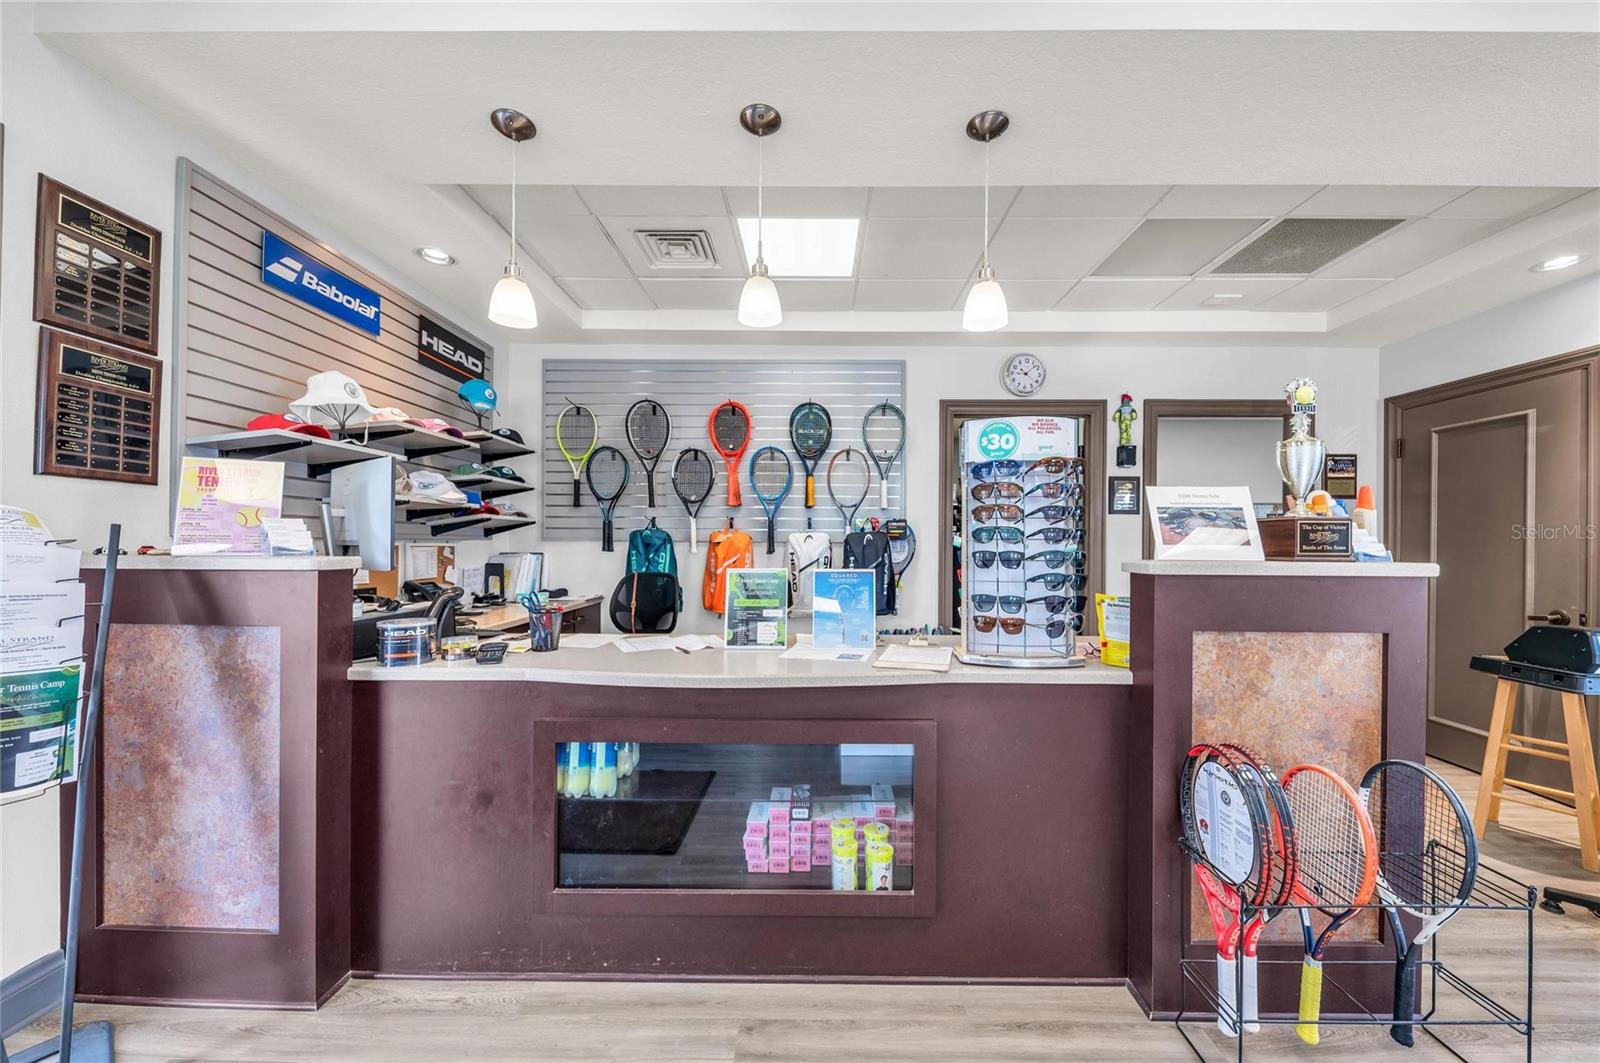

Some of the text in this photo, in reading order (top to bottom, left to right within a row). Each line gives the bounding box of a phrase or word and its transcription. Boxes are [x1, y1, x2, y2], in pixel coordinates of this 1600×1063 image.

[421, 330, 483, 374] HEAD
[980, 433, 1015, 450] $30
[790, 552, 798, 592] HEAD
[384, 629, 426, 637] HEAD
[7, 682, 38, 693] Tennis
[40, 680, 66, 689] Camp
[1203, 766, 1238, 790] kinetic
